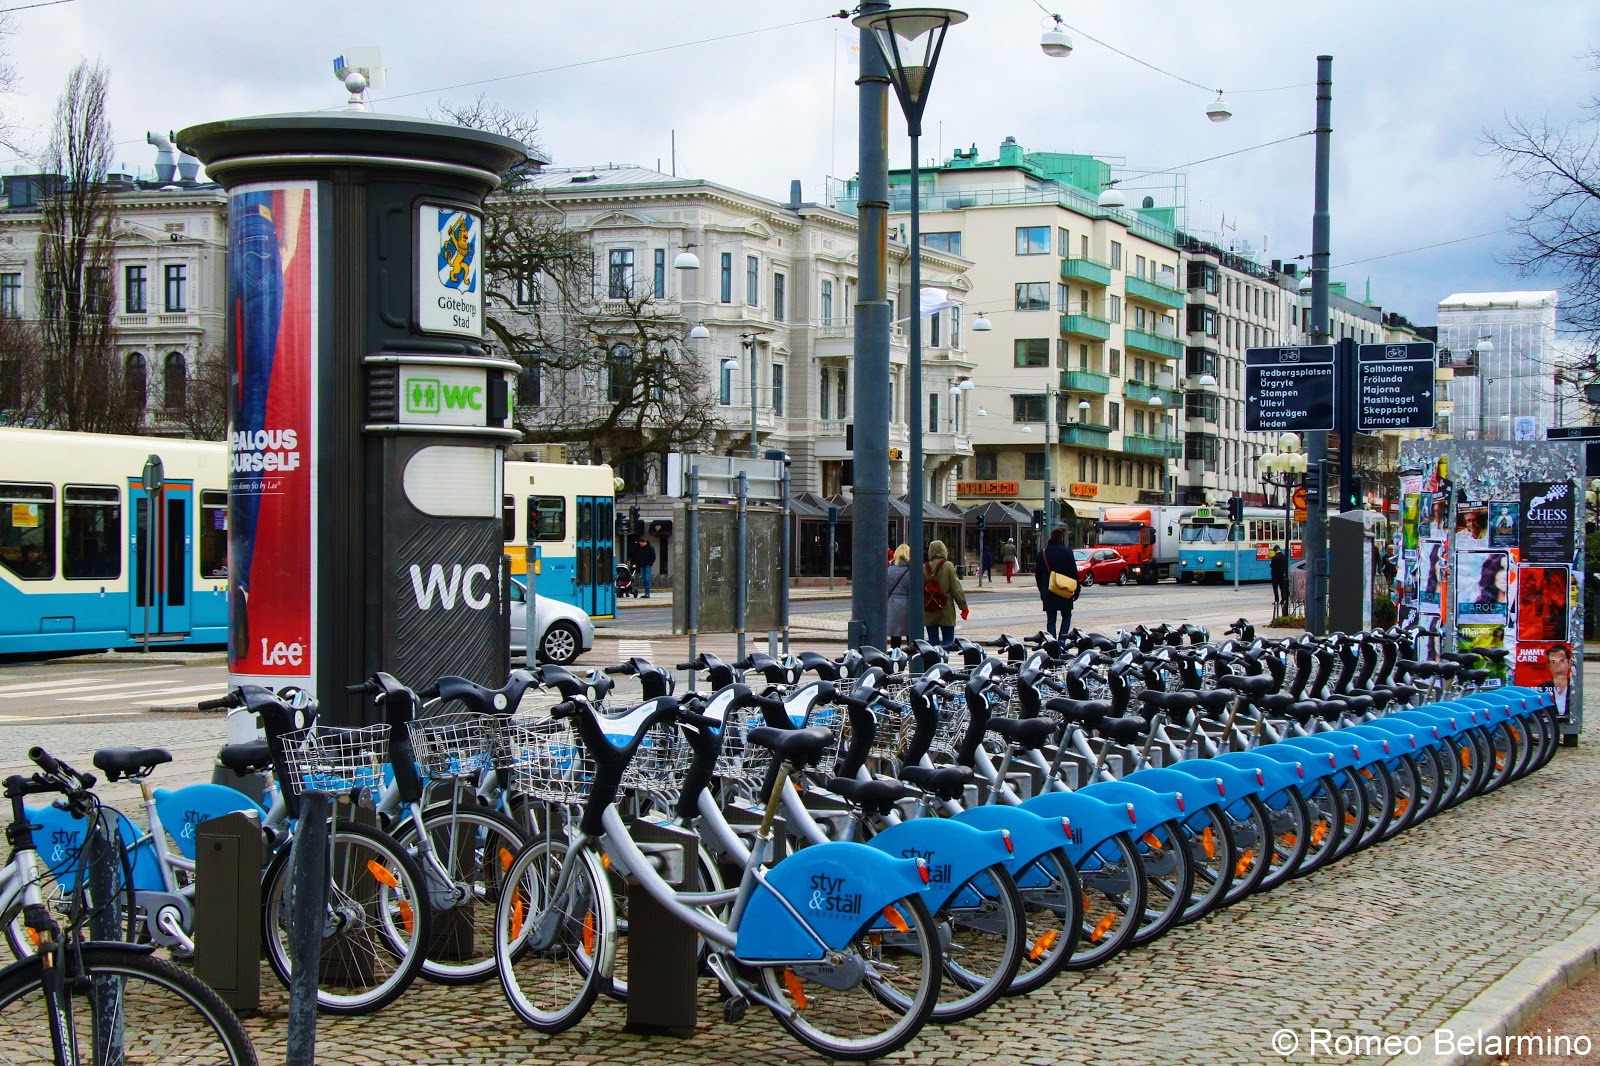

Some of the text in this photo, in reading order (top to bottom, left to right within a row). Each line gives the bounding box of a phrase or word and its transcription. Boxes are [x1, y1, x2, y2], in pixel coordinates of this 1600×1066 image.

[437, 296, 477, 318] Göteborgs
[452, 315, 470, 329] Stad
[1260, 368, 1332, 378] Redbergsplatsen
[1363, 365, 1414, 373] Saltholmen
[1260, 378, 1294, 388] Örgryte
[1363, 375, 1403, 383] Frölunda
[1260, 389, 1298, 398] Stampen
[1363, 386, 1400, 395] Majorna
[443, 384, 483, 411] WC
[1363, 395, 1415, 405] Masthugget
[1260, 399, 1285, 407] Ullevi
[1260, 409, 1307, 418] Korsvägen
[1363, 406, 1419, 415] Skeppsbron
[1260, 420, 1287, 428] Heden
[1363, 416, 1410, 425] Järntorget
[1527, 508, 1568, 521] CHESS
[409, 563, 492, 610] WC
[1461, 603, 1504, 613] CAROLA
[181, 822, 194, 839] &
[52, 828, 81, 847] styr
[52, 844, 63, 862] &
[810, 873, 846, 896] styr
[808, 890, 862, 915] & ställ
